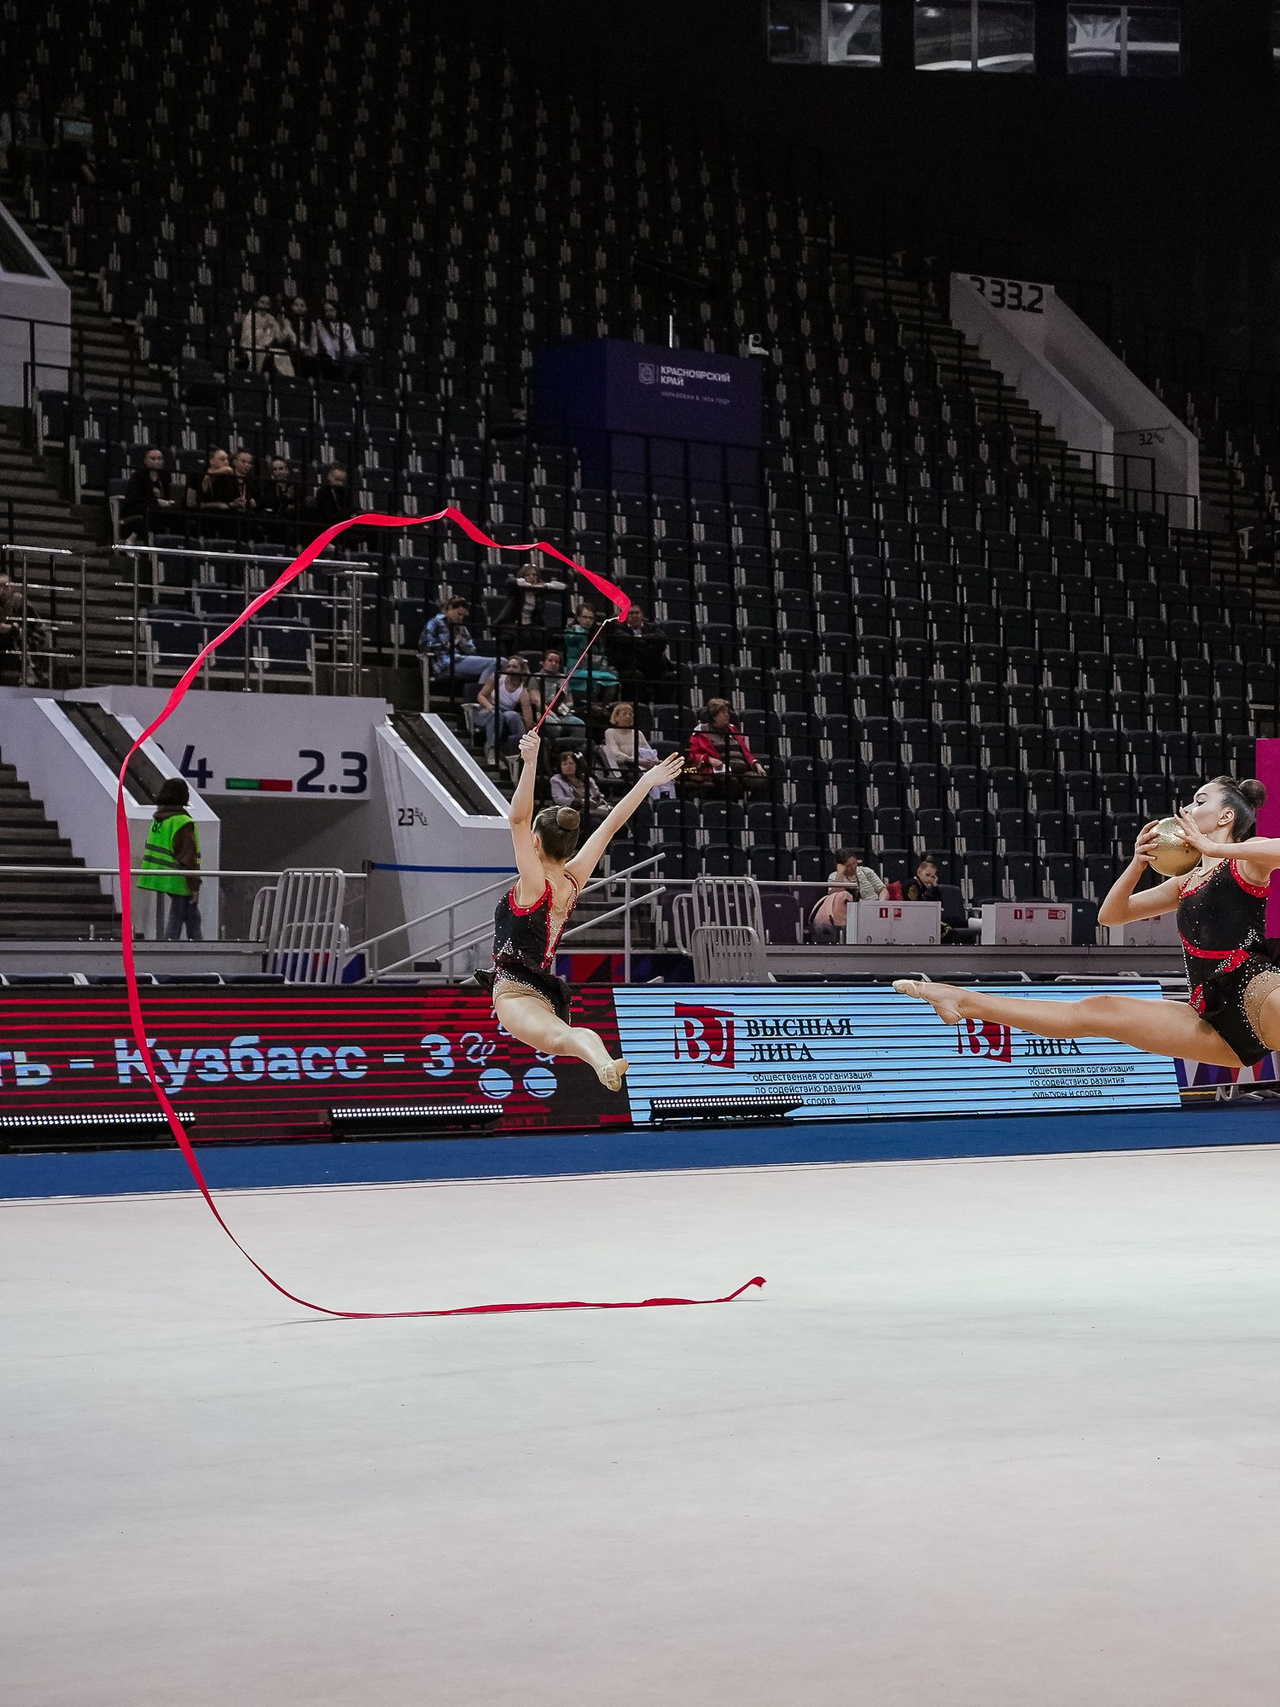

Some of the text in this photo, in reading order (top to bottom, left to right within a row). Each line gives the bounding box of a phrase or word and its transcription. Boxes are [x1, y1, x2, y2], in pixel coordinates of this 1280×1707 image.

[660, 366, 731, 382] КРАСНОЯРСКИЙ
[660, 375, 684, 386] КРАЙ
[297, 750, 367, 793] 2.3
[744, 1018, 854, 1038] ВЫСШАЯ
[750, 1043, 815, 1062] ЛИГА
[1024, 1038, 1083, 1056] ЛИГА
[114, 1035, 369, 1095] Кузбасс
[1028, 1065, 1135, 1075] общественная организация
[753, 1072, 873, 1082] общественная организация
[1041, 1078, 1089, 1087] содействию
[1090, 1077, 1125, 1085] развития
[755, 1084, 862, 1095] по содействию развития
